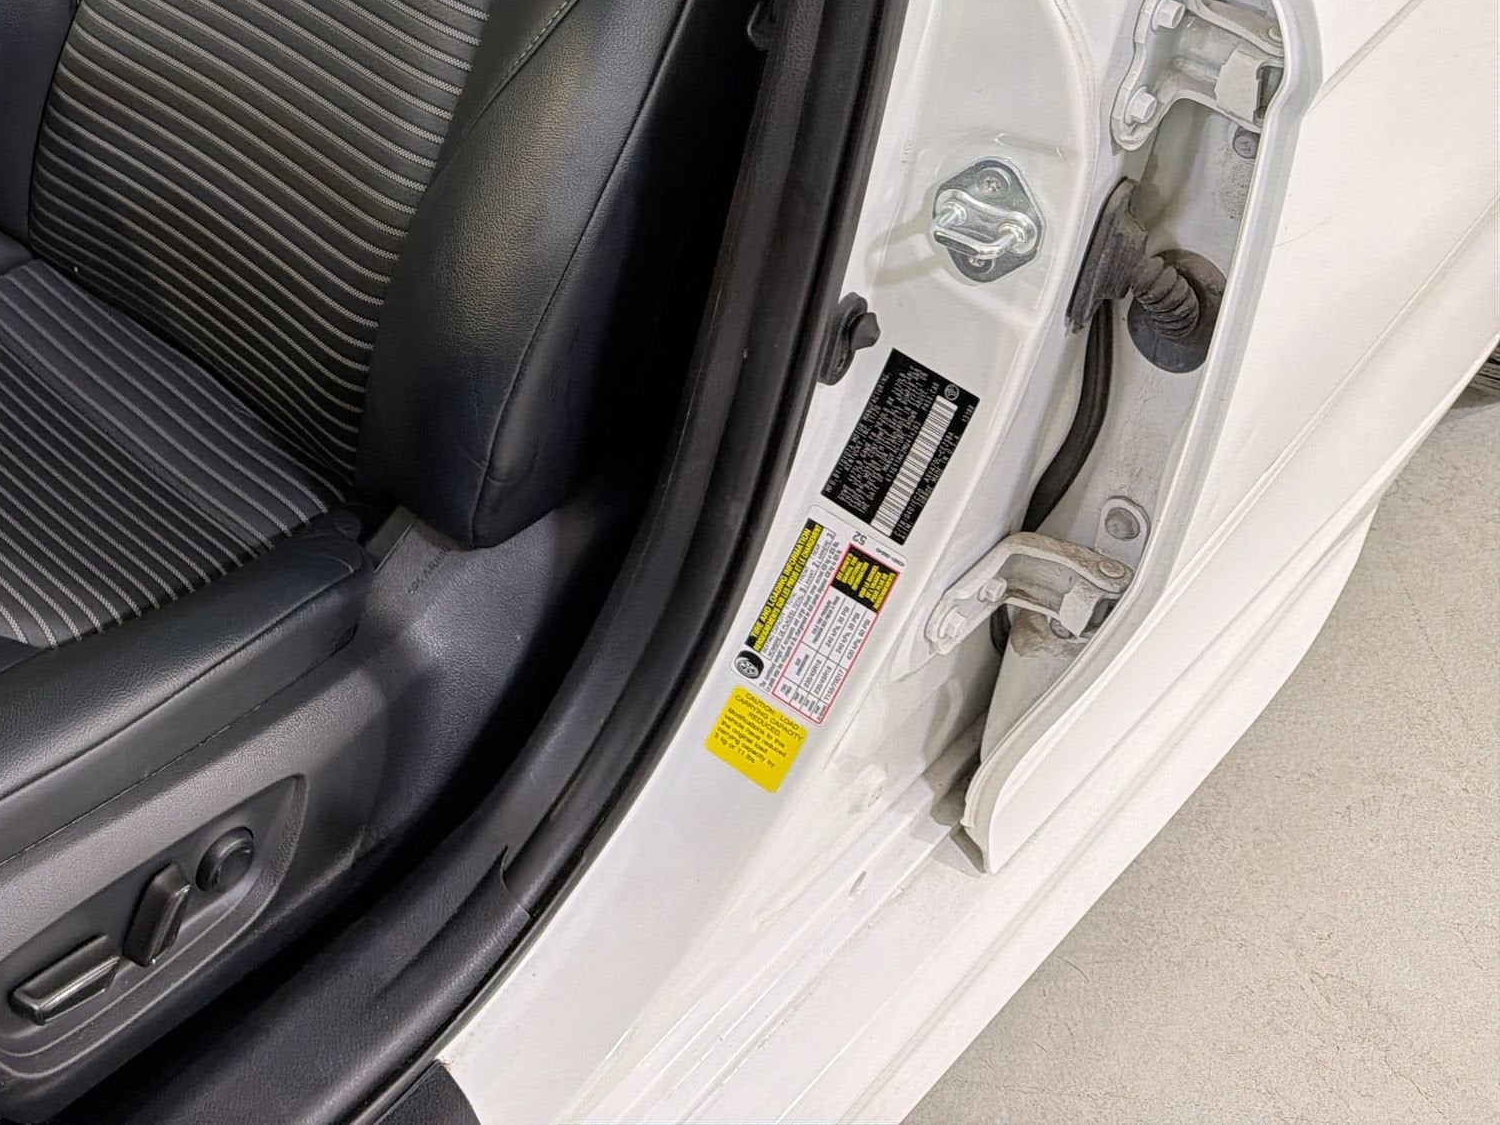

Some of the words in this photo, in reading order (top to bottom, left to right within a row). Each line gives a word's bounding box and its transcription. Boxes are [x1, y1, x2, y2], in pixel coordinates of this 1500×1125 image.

[851, 530, 867, 546] 52
[750, 620, 764, 638] TIRE
[758, 605, 772, 622] AND
[766, 574, 788, 606] LOADING
[781, 527, 812, 576] INFORMATION
[727, 706, 766, 736] Modifications
[765, 732, 773, 740] to
[734, 693, 769, 720] CARRYING
[769, 716, 803, 743] CAPACITY
[779, 714, 799, 731] LOAD
